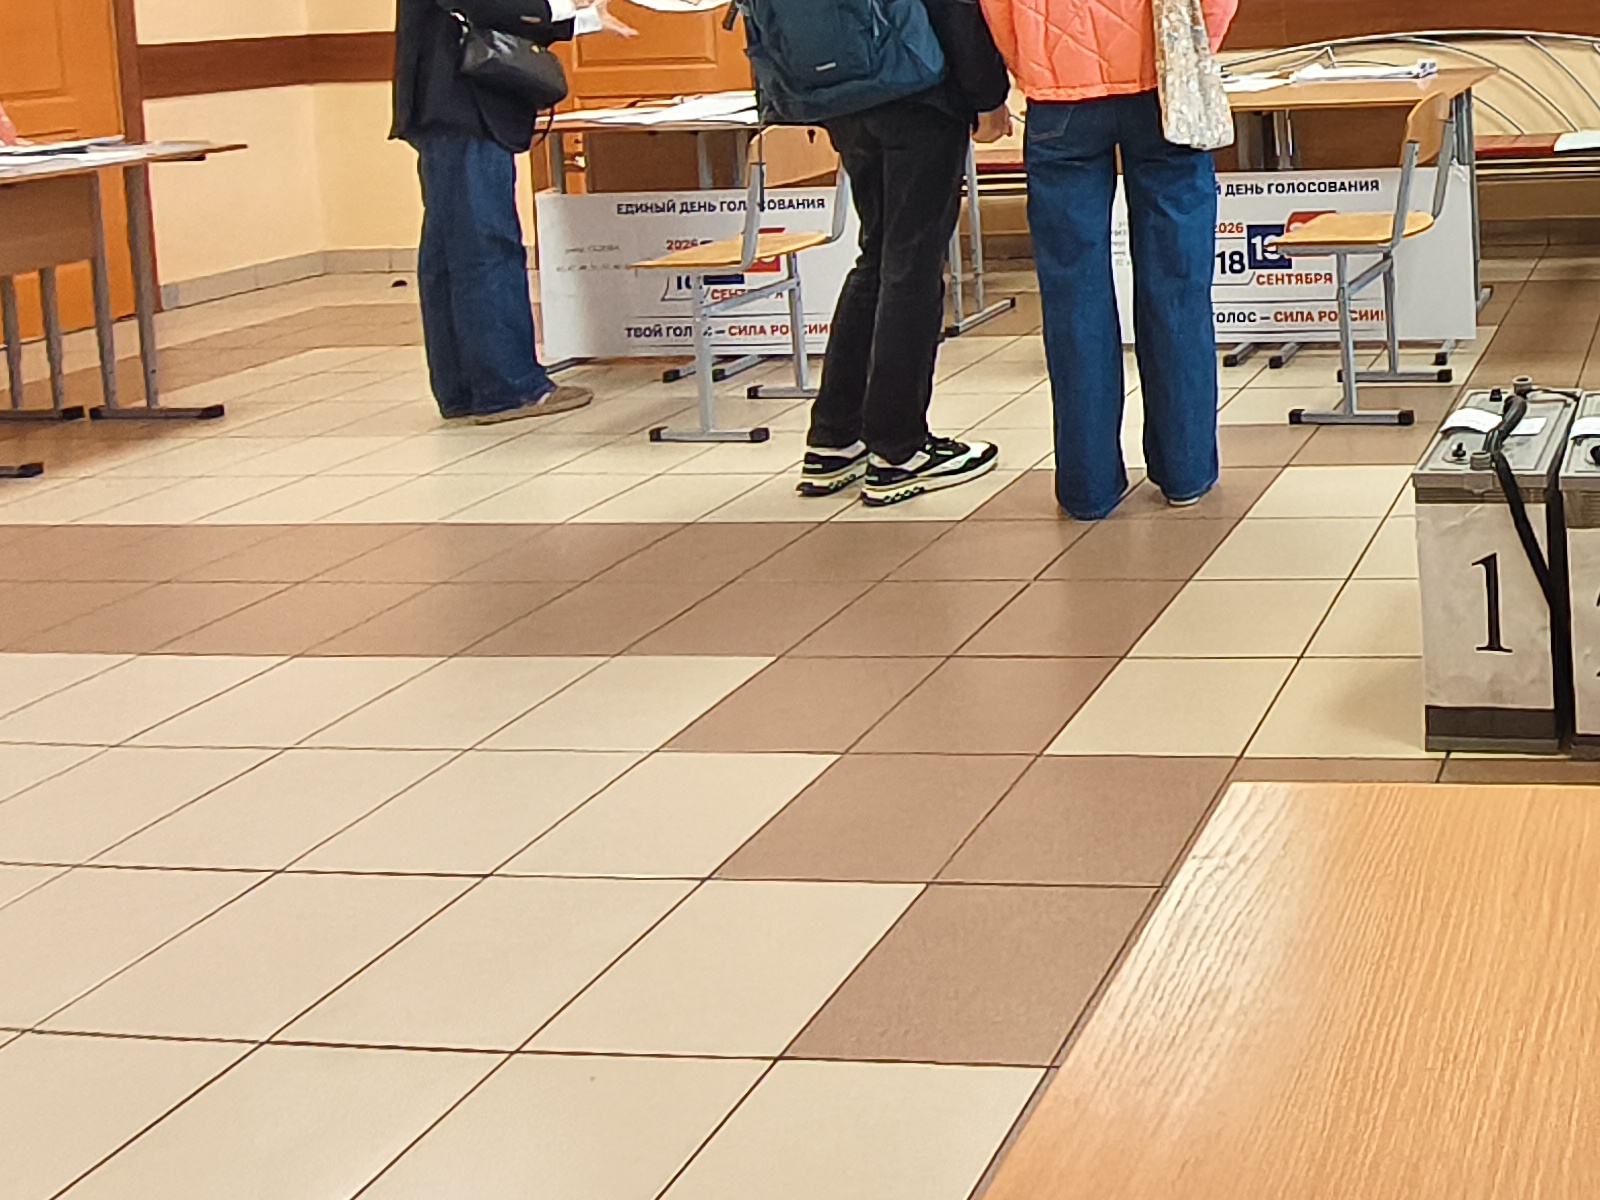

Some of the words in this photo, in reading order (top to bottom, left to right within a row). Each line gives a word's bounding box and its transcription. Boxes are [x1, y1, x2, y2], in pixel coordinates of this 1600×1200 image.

[1225, 184, 1263, 197] ДЕНЬ
[1267, 180, 1379, 195] ГОЛОСОВАНИЯ
[617, 199, 675, 214] ЕДИНЫЙ
[679, 201, 717, 214] ДЕНЬ
[1216, 251, 1246, 274] 18
[1256, 272, 1333, 286] СЕНТЯБРЯ
[1214, 311, 1256, 324] ОЛОС
[1274, 311, 1315, 323] СИЛА
[626, 324, 663, 338] ТВОЙ
[729, 324, 767, 336] СИЛА
[1472, 552, 1514, 653] 1
